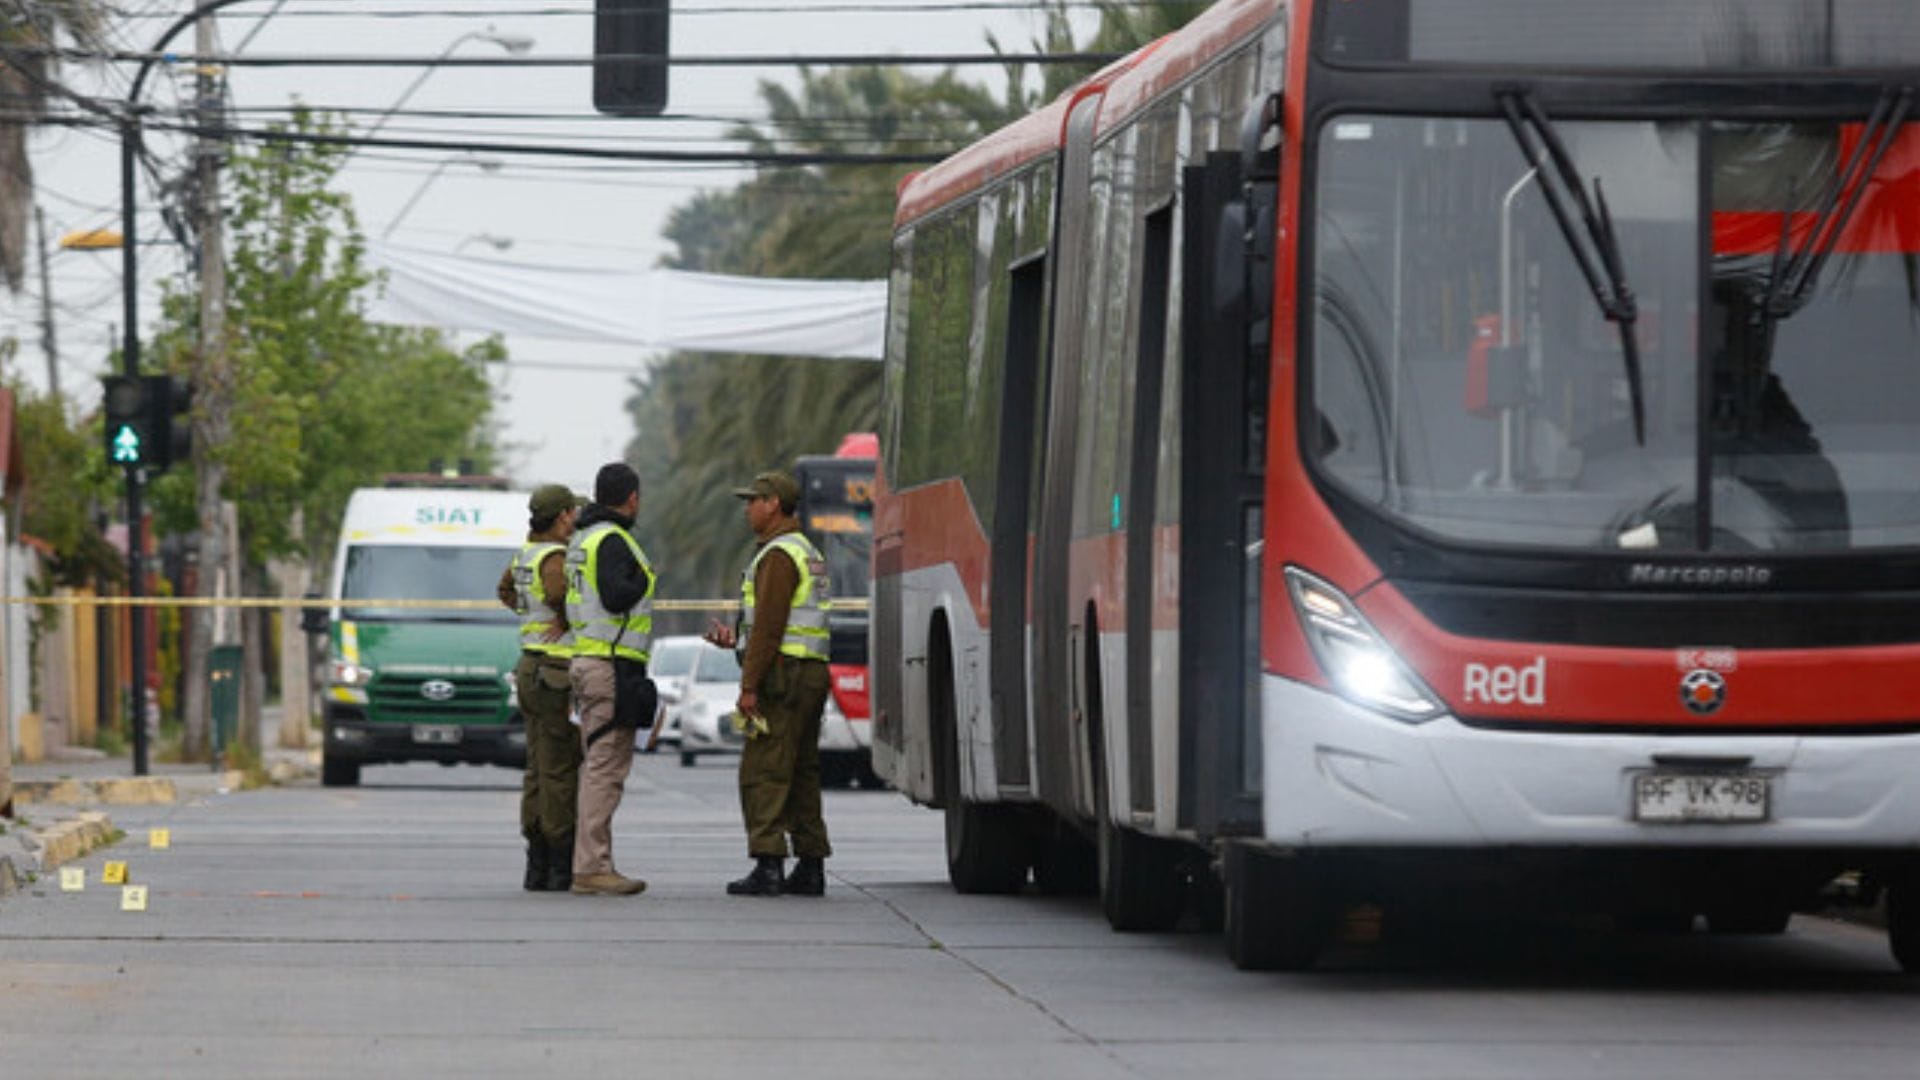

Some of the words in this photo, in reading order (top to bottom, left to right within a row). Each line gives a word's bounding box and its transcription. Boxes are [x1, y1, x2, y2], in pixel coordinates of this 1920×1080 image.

[416, 507, 484, 525] SIAT
[1630, 563, 1772, 584] Marcopolo
[1463, 656, 1547, 706] Red
[1641, 780, 1674, 804] PF
